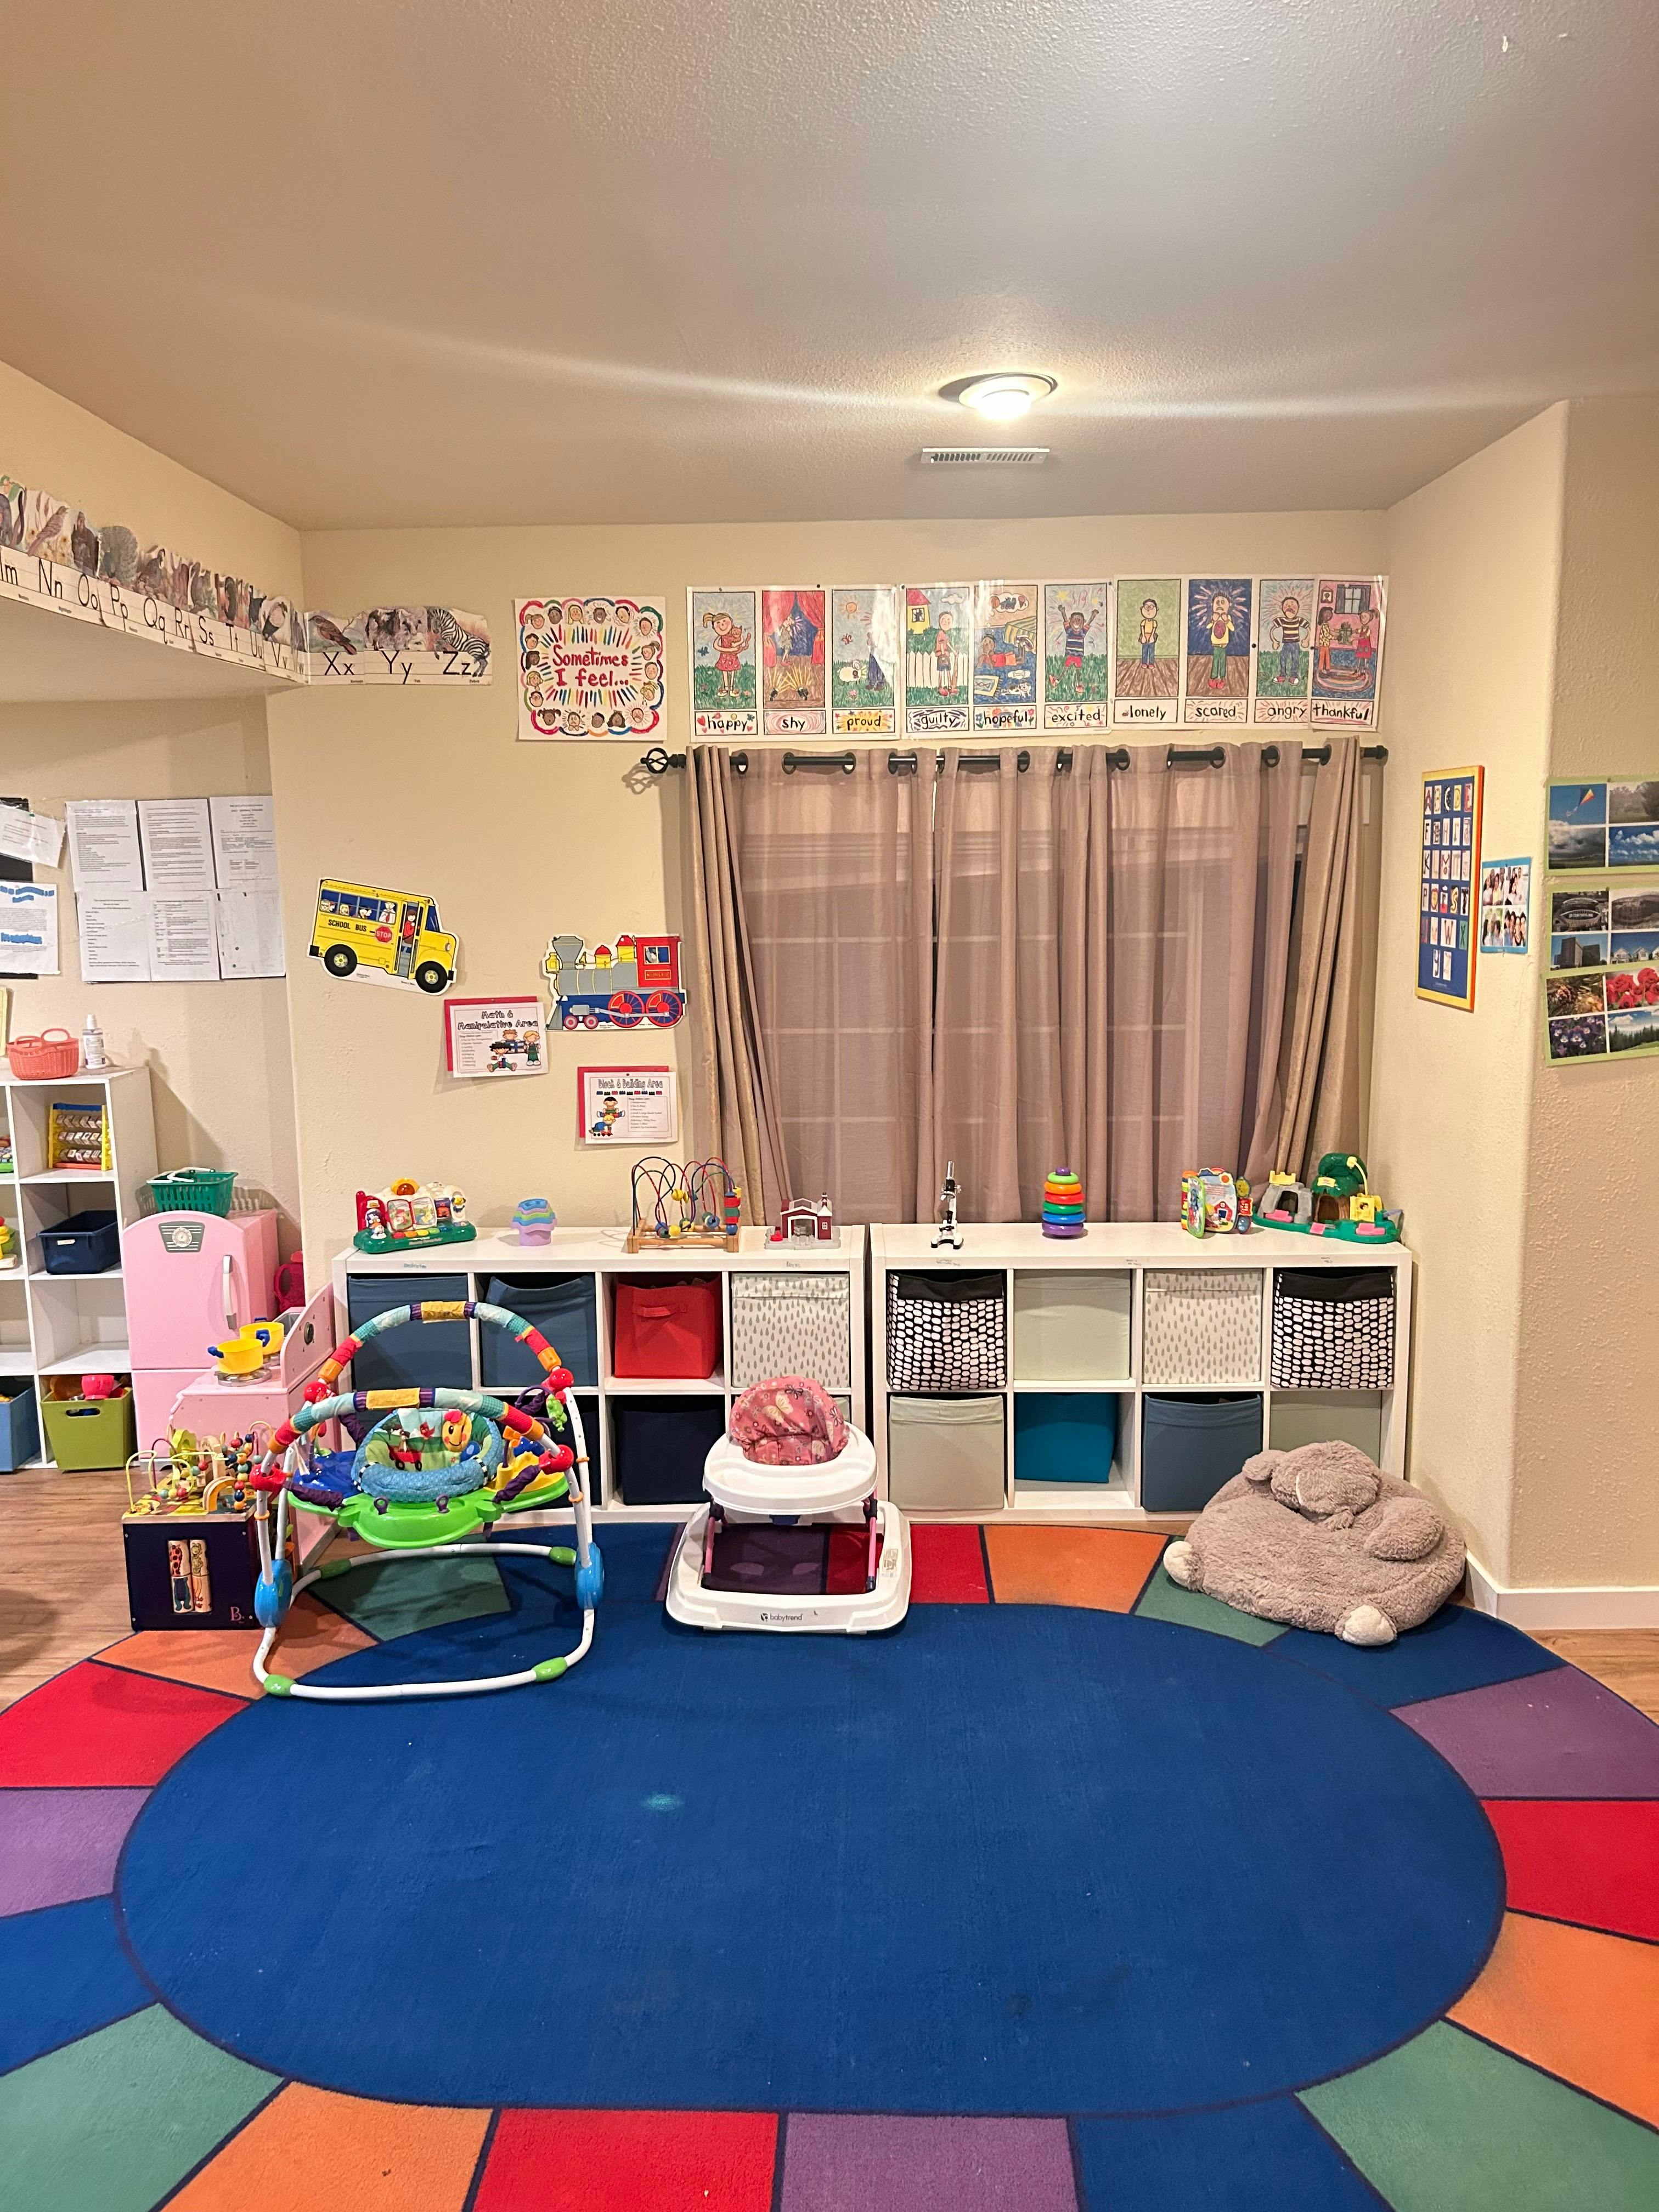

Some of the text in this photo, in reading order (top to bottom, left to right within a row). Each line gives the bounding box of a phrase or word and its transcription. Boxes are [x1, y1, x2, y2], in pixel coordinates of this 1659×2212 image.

[552, 644, 629, 667] Sometimes
[323, 650, 472, 685] Xx Yy Zz
[555, 668, 629, 687] I feel...
[984, 710, 1029, 728] hopeful
[1052, 709, 1101, 723] excited
[1130, 704, 1166, 720] lonely
[1195, 705, 1235, 718] scared
[1267, 707, 1307, 719] angry
[1313, 703, 1369, 720] thankful
[707, 714, 748, 731] happy
[782, 716, 805, 731] shy
[847, 715, 881, 730] proud
[922, 713, 956, 729] guilty
[328, 919, 351, 929] SCHOOL
[481, 1010, 505, 1019] Math
[458, 1020, 512, 1030] Manipulative
[598, 1079, 614, 1088] Block
[623, 1079, 646, 1090] Building
[647, 1079, 663, 1088] Area
